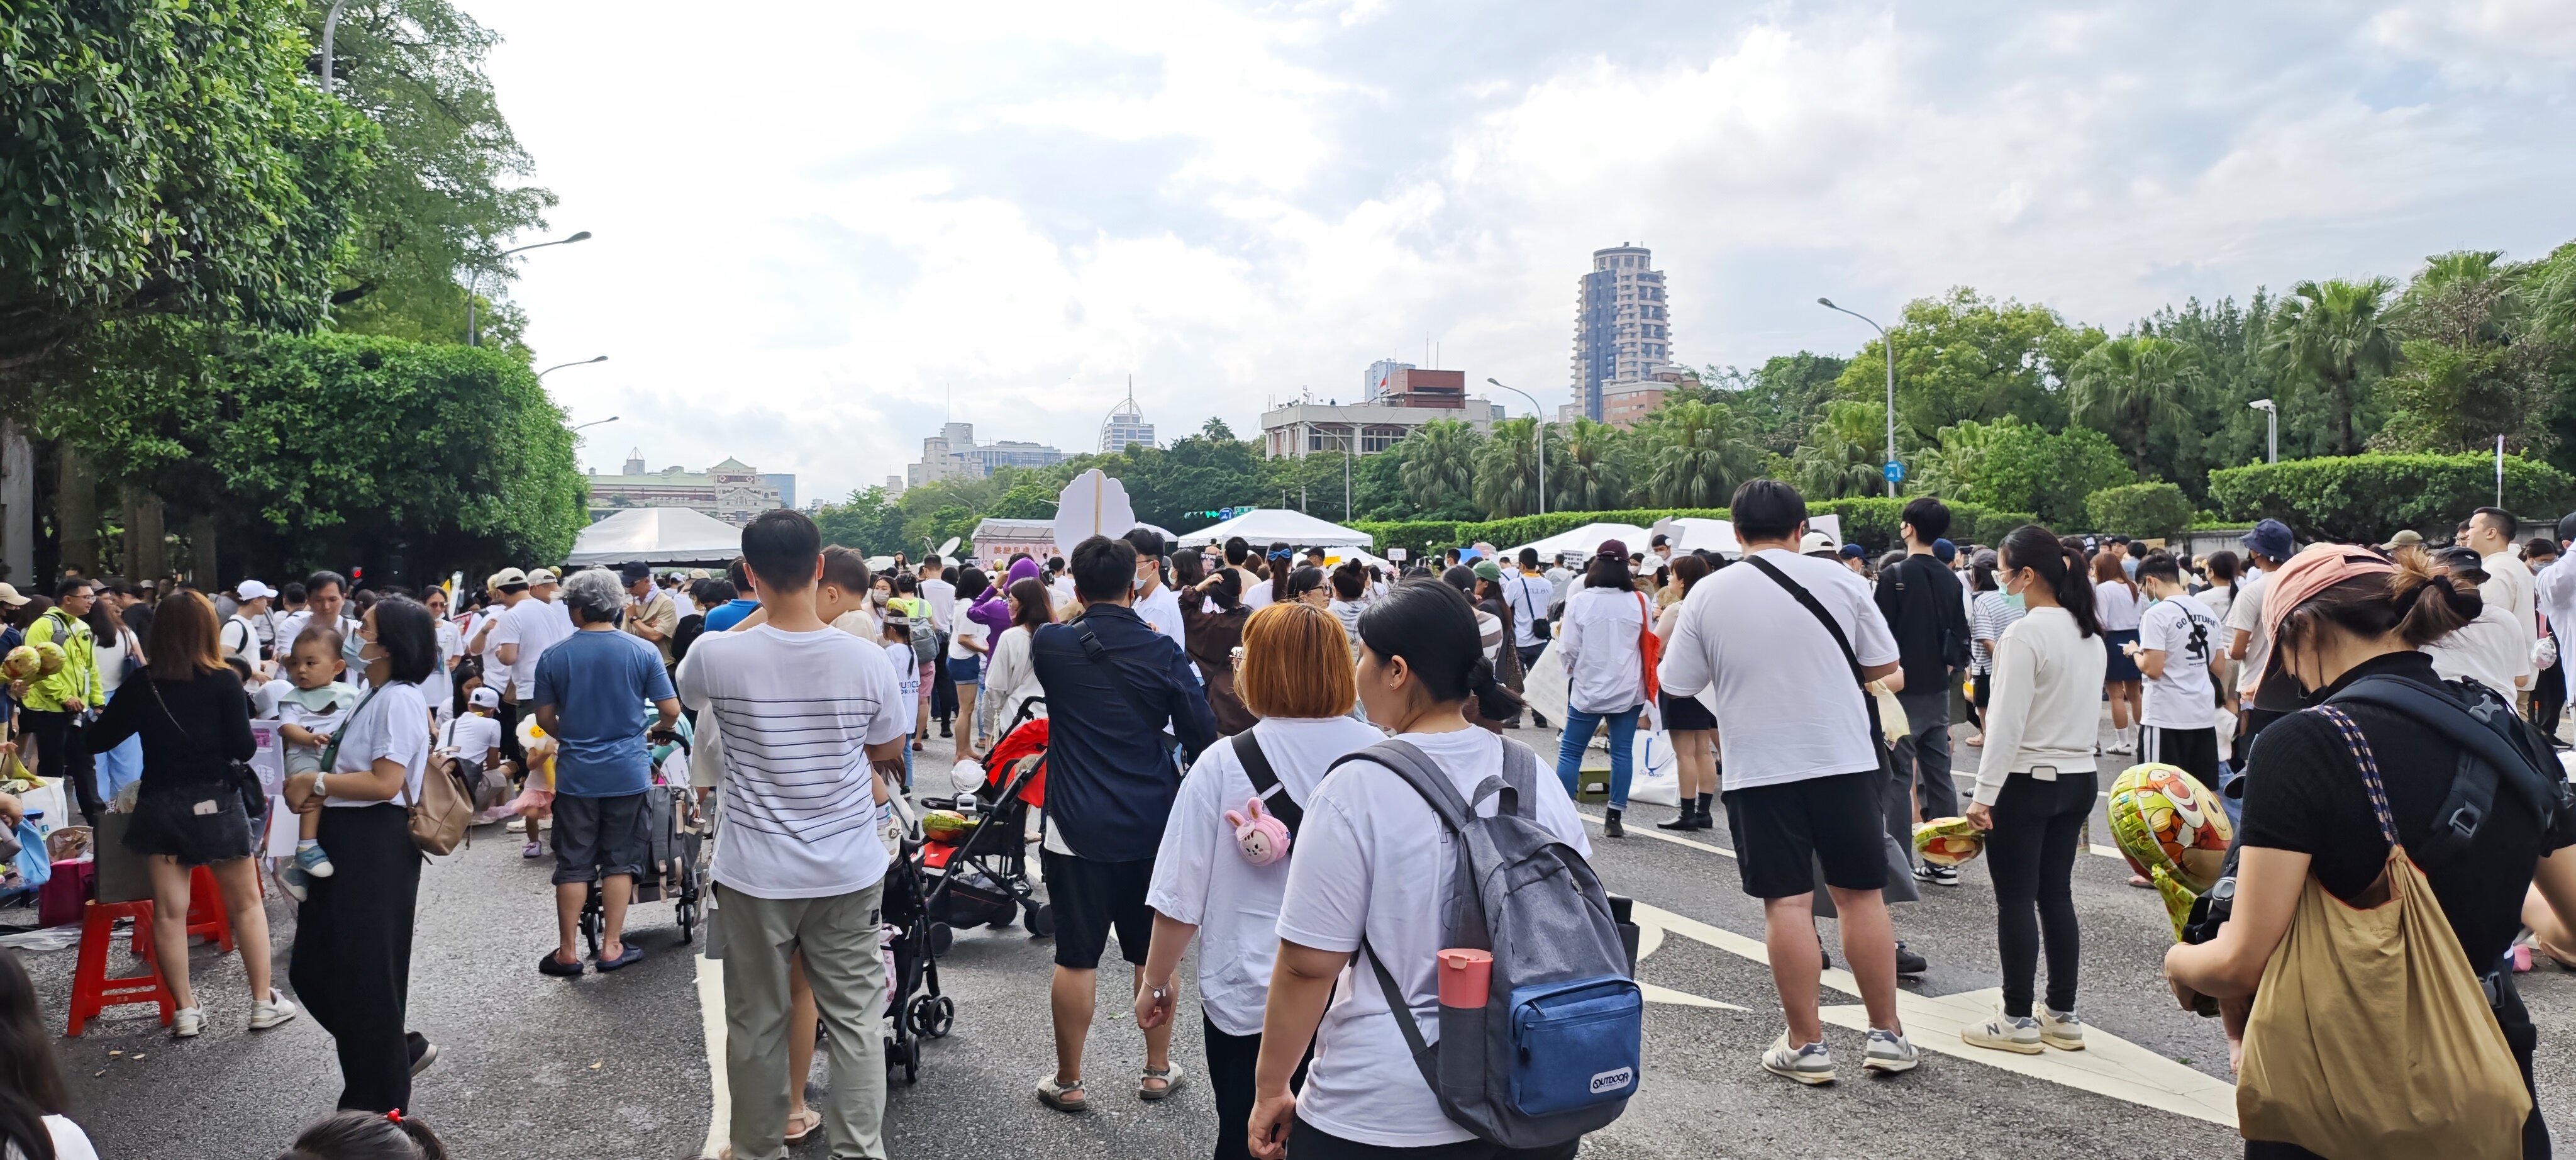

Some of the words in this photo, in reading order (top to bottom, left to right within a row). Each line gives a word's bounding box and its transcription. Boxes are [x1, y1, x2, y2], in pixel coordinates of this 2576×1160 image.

[2176, 618, 2187, 629] GO
[2189, 614, 2216, 628] UTURE
[1592, 1072, 1629, 1090] OUTDOOR
